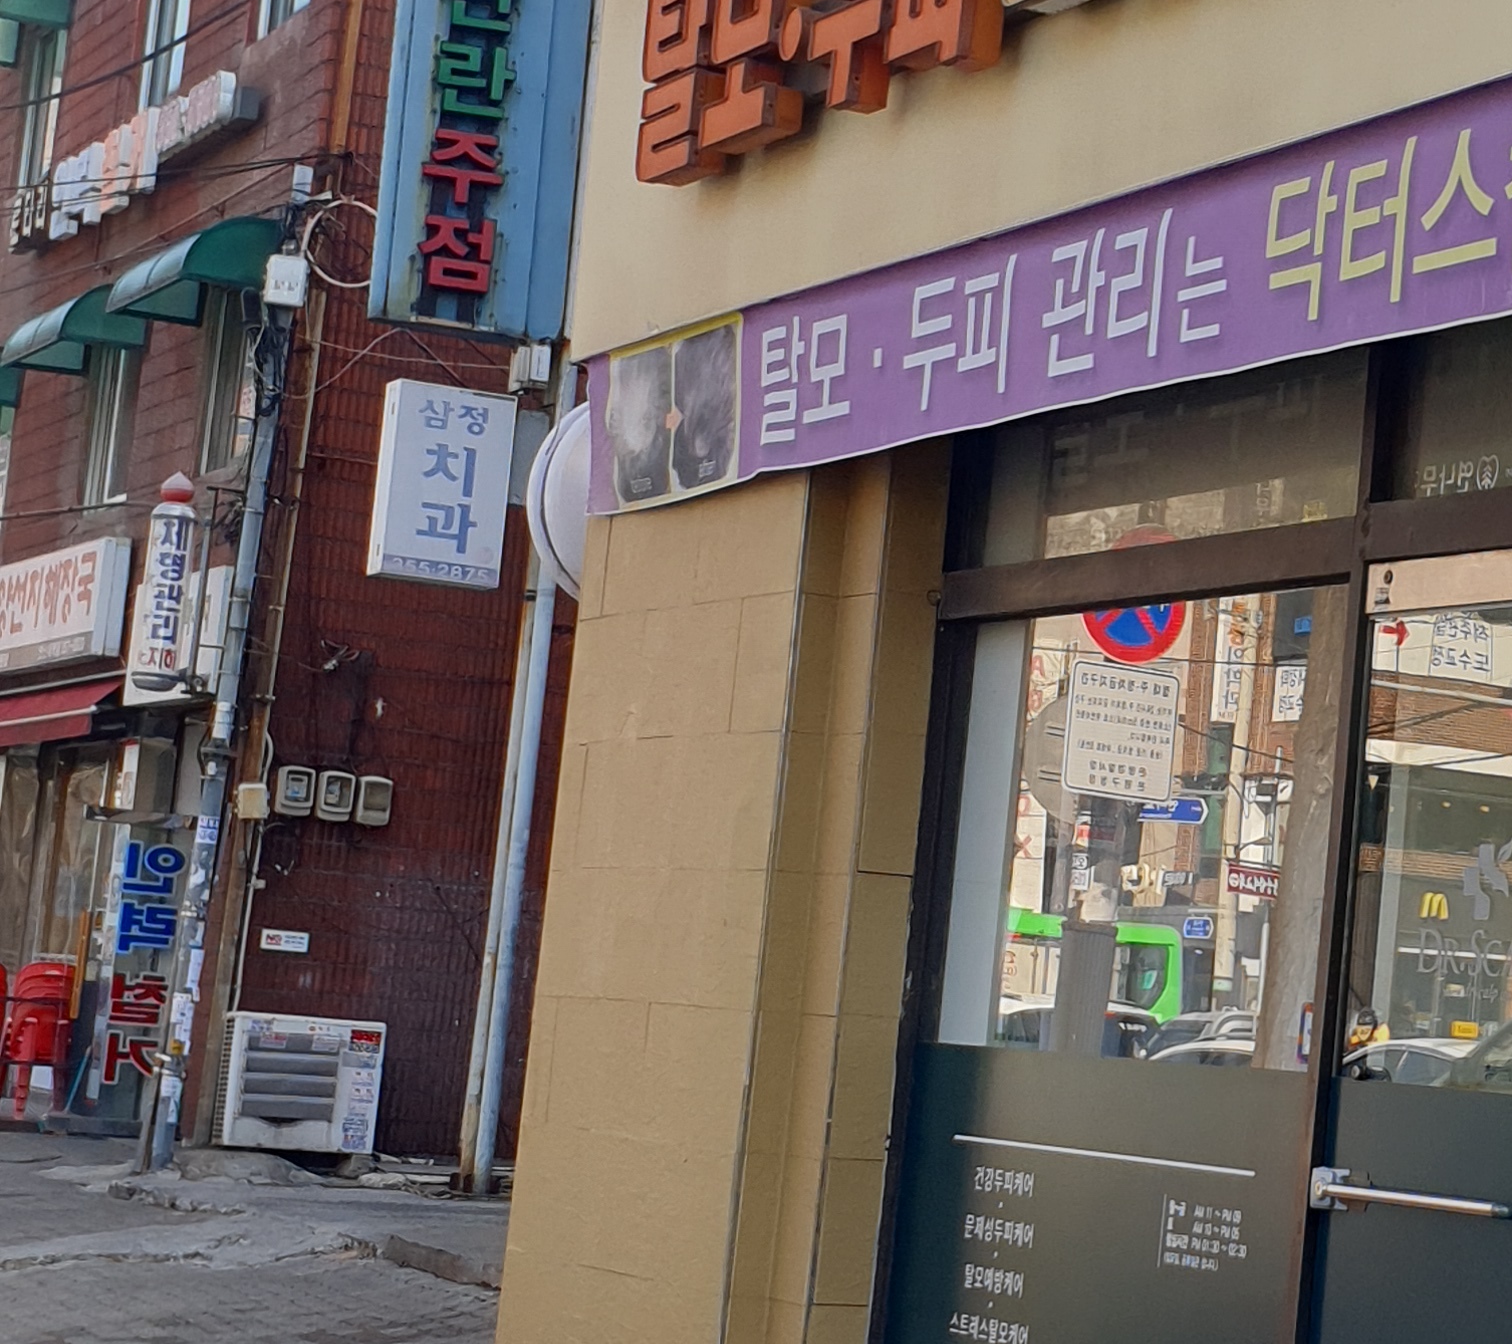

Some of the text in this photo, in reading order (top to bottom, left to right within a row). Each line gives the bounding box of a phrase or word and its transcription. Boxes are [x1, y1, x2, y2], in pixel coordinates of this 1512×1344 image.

[1042, 208, 1228, 377] 관리는
[418, 399, 491, 436] 삼정
[415, 442, 479, 554] 치과
[974, 1165, 1035, 1198] 건강두피케어
[963, 1213, 1035, 1249] 문제성두피케어
[964, 1263, 1025, 1299] 탈모예방케어
